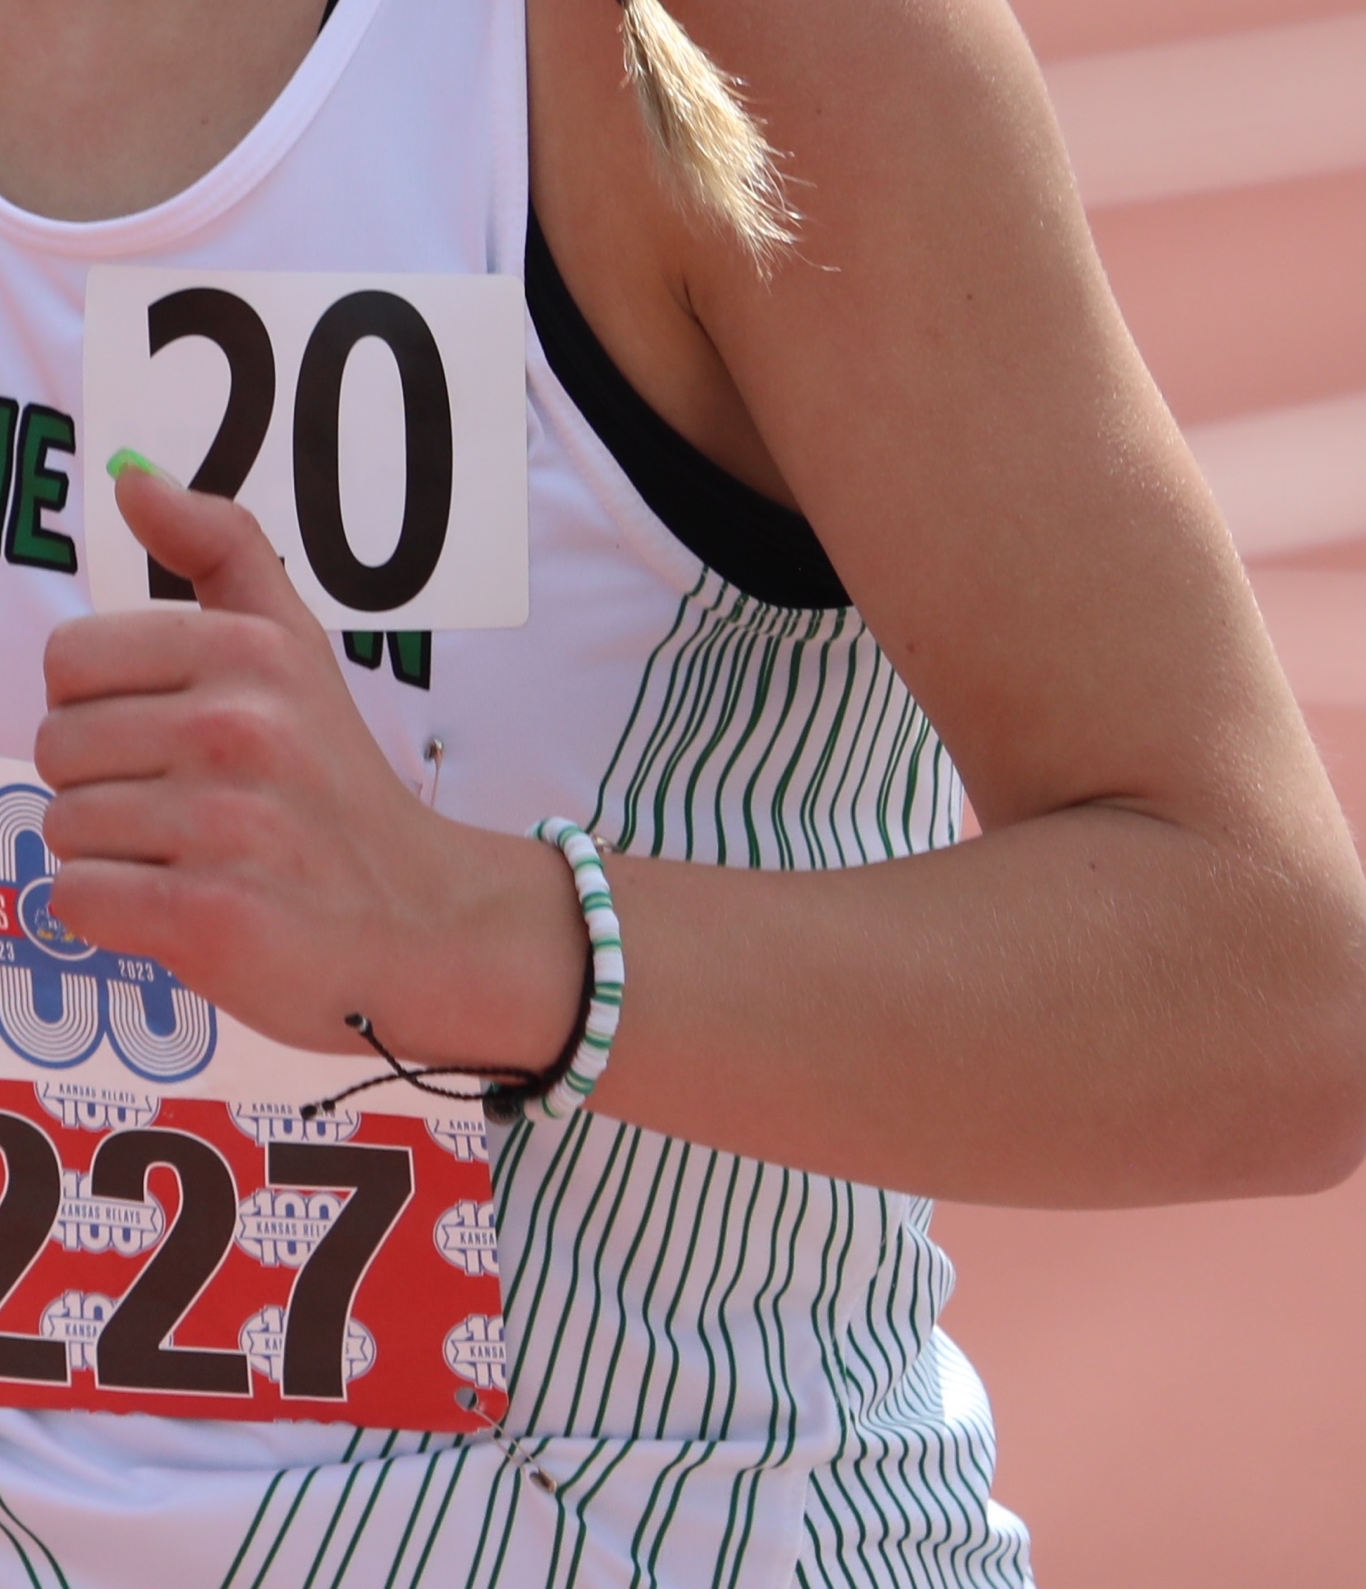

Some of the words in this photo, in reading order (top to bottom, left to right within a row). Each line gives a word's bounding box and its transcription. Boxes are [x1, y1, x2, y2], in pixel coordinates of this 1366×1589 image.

[147, 287, 453, 612] 20
[118, 958, 154, 982] 2023
[61, 1203, 100, 1220] KANSAS
[105, 1208, 141, 1225] RELAYS
[256, 1221, 297, 1237] KANSAS
